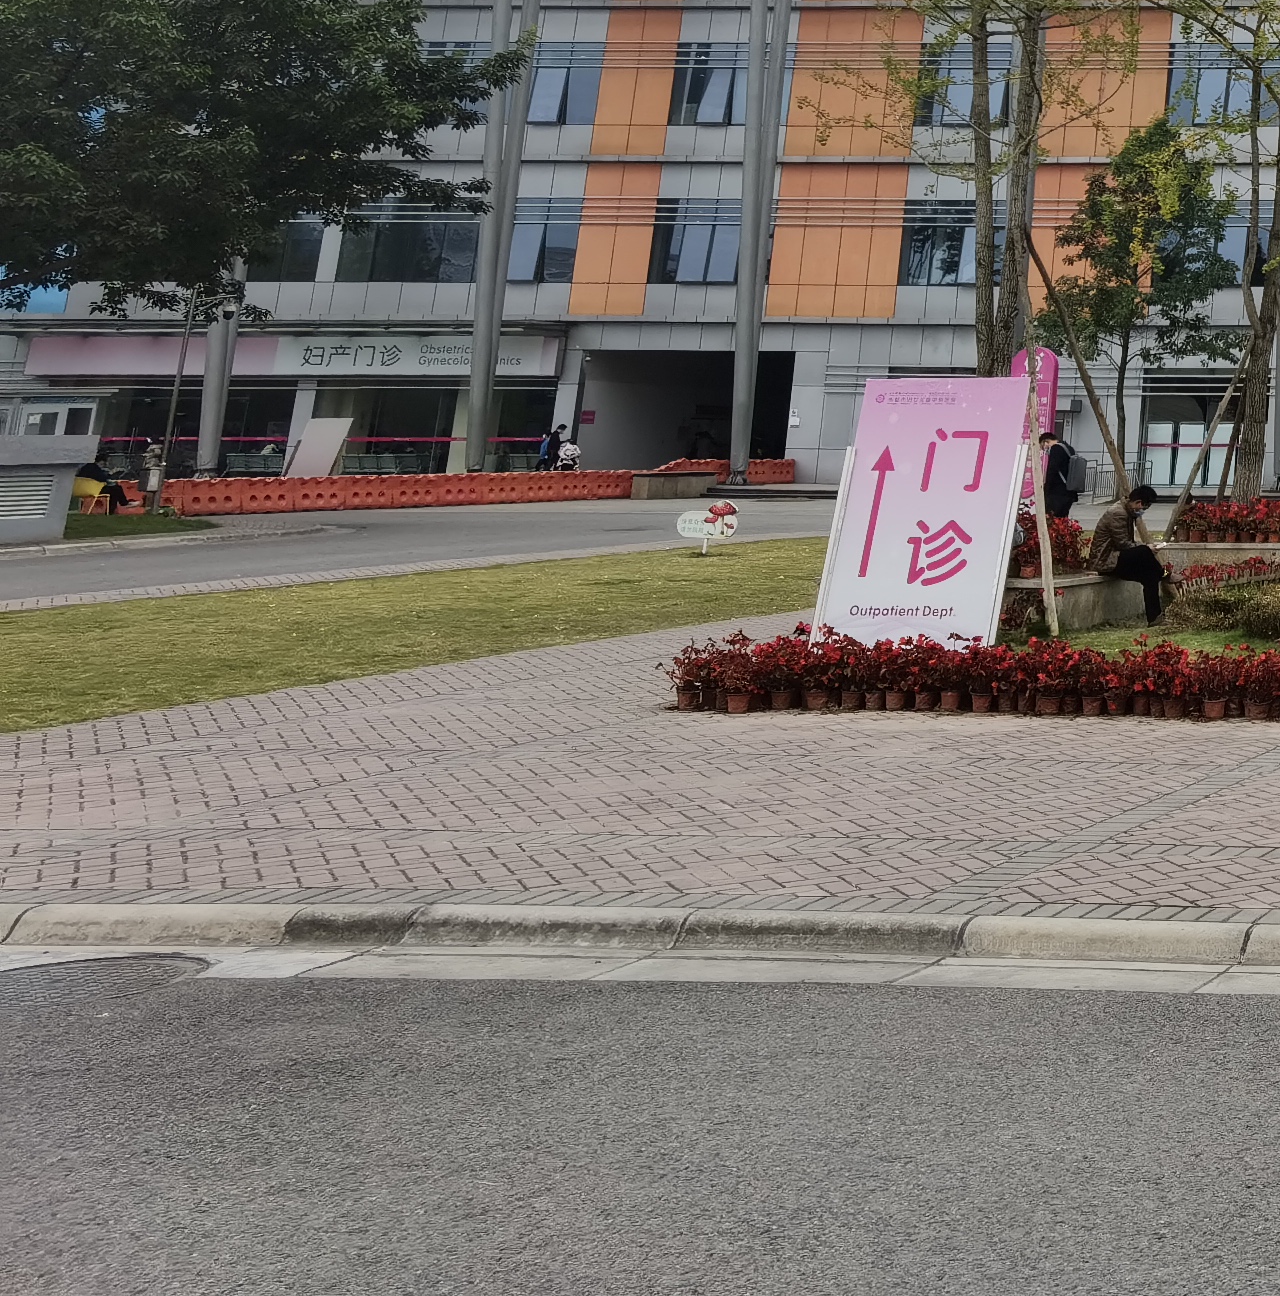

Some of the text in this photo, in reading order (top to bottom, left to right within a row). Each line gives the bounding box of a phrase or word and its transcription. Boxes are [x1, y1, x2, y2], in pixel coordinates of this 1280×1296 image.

[300, 344, 402, 367] 妇产门诊
[418, 356, 472, 367] Gynecolo
[907, 428, 989, 586] 门诊
[849, 605, 956, 618] Outpatient Dept.
